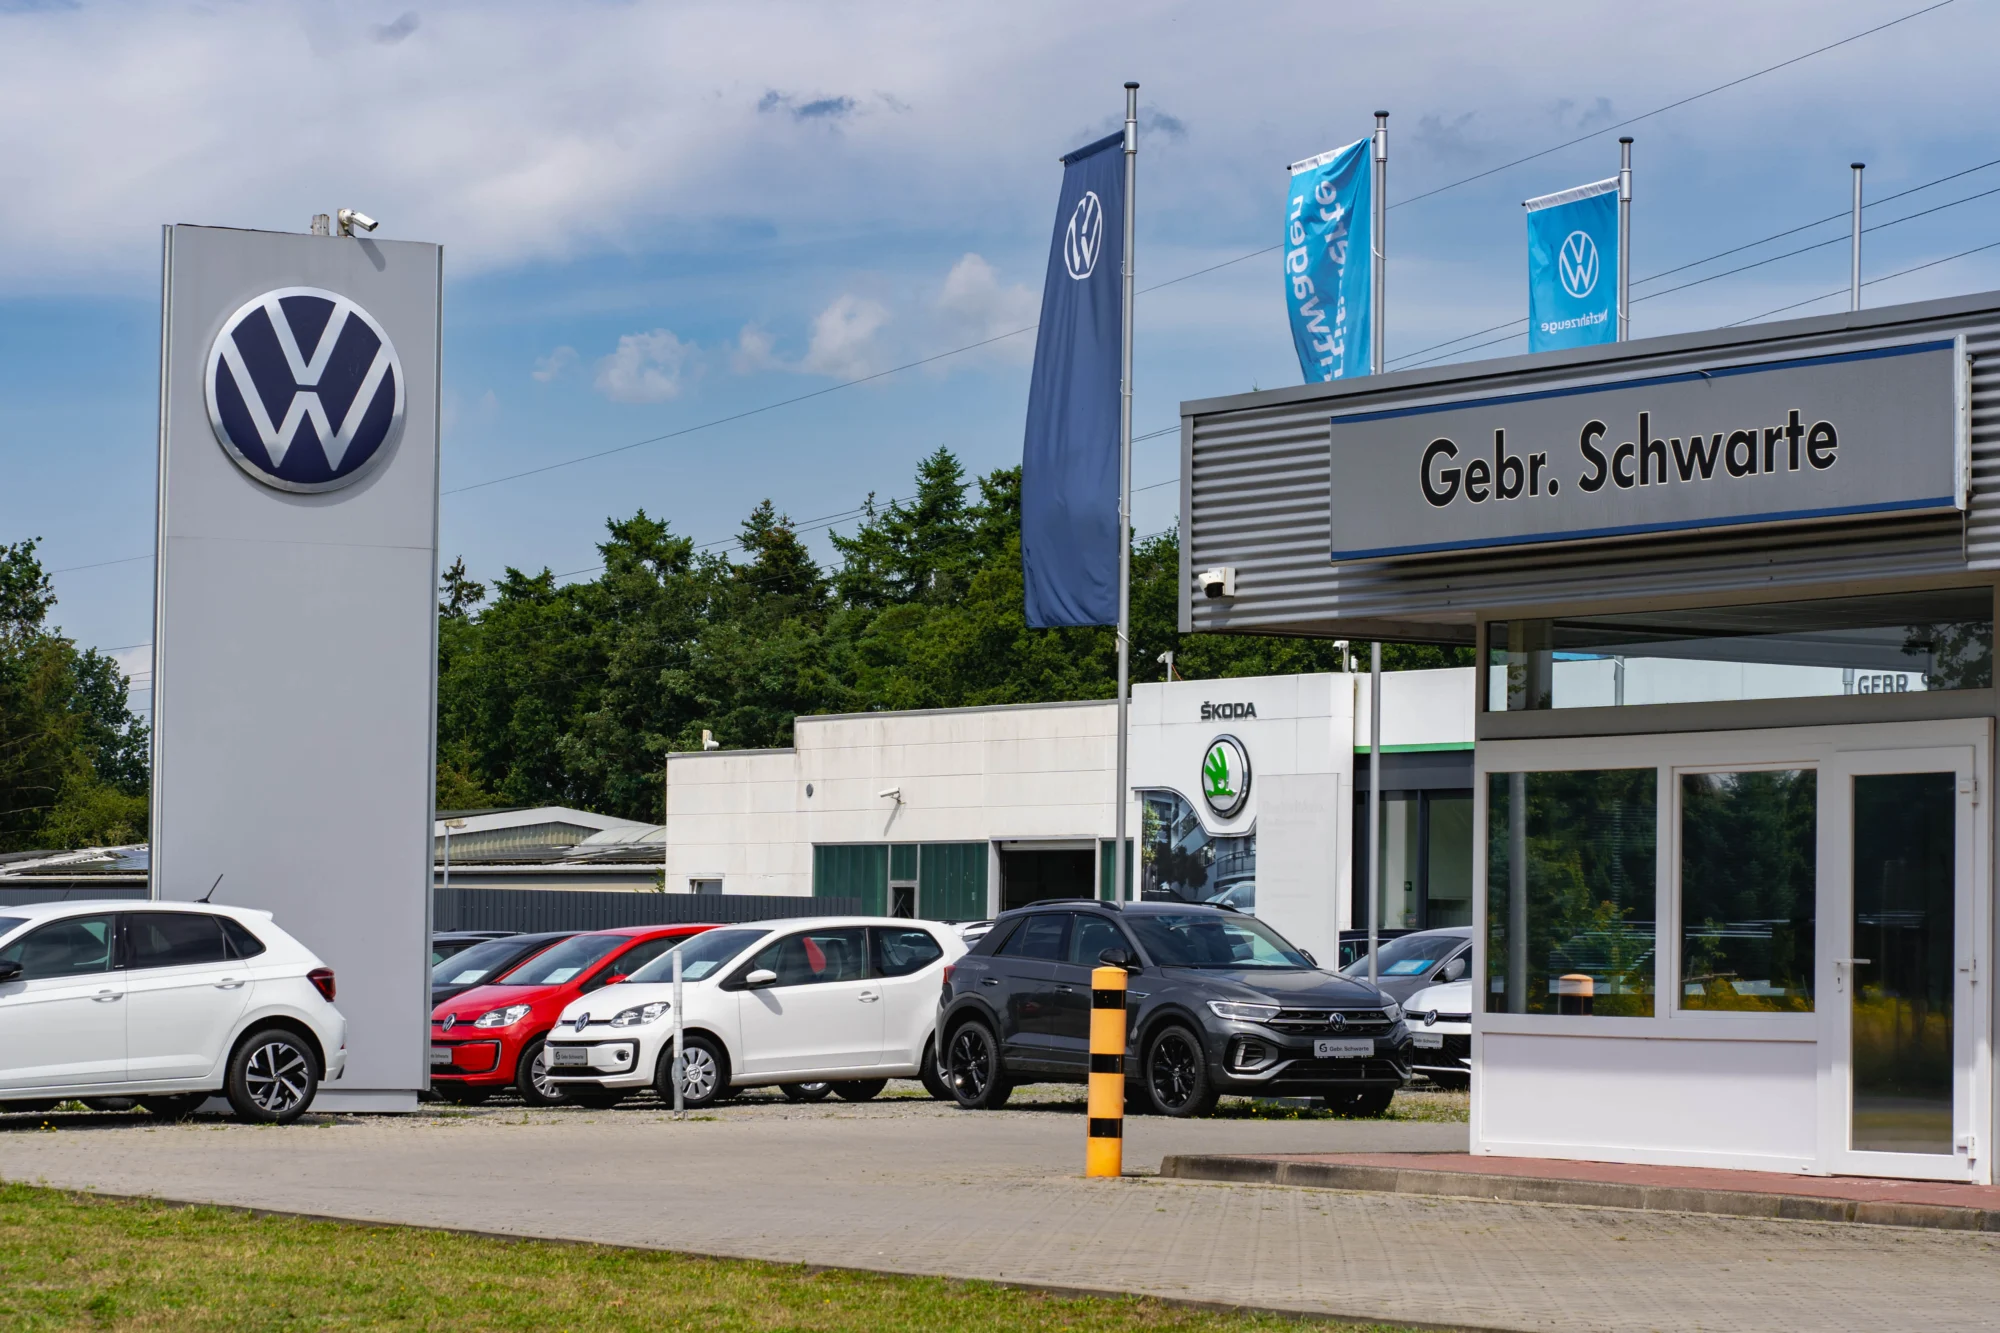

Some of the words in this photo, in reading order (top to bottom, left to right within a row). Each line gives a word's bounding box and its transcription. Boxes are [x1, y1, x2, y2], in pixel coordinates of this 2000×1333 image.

[1419, 427, 1559, 508] Gebr.
[1578, 408, 1839, 494] Schwarte
[1200, 700, 1257, 720] ŠKODA
